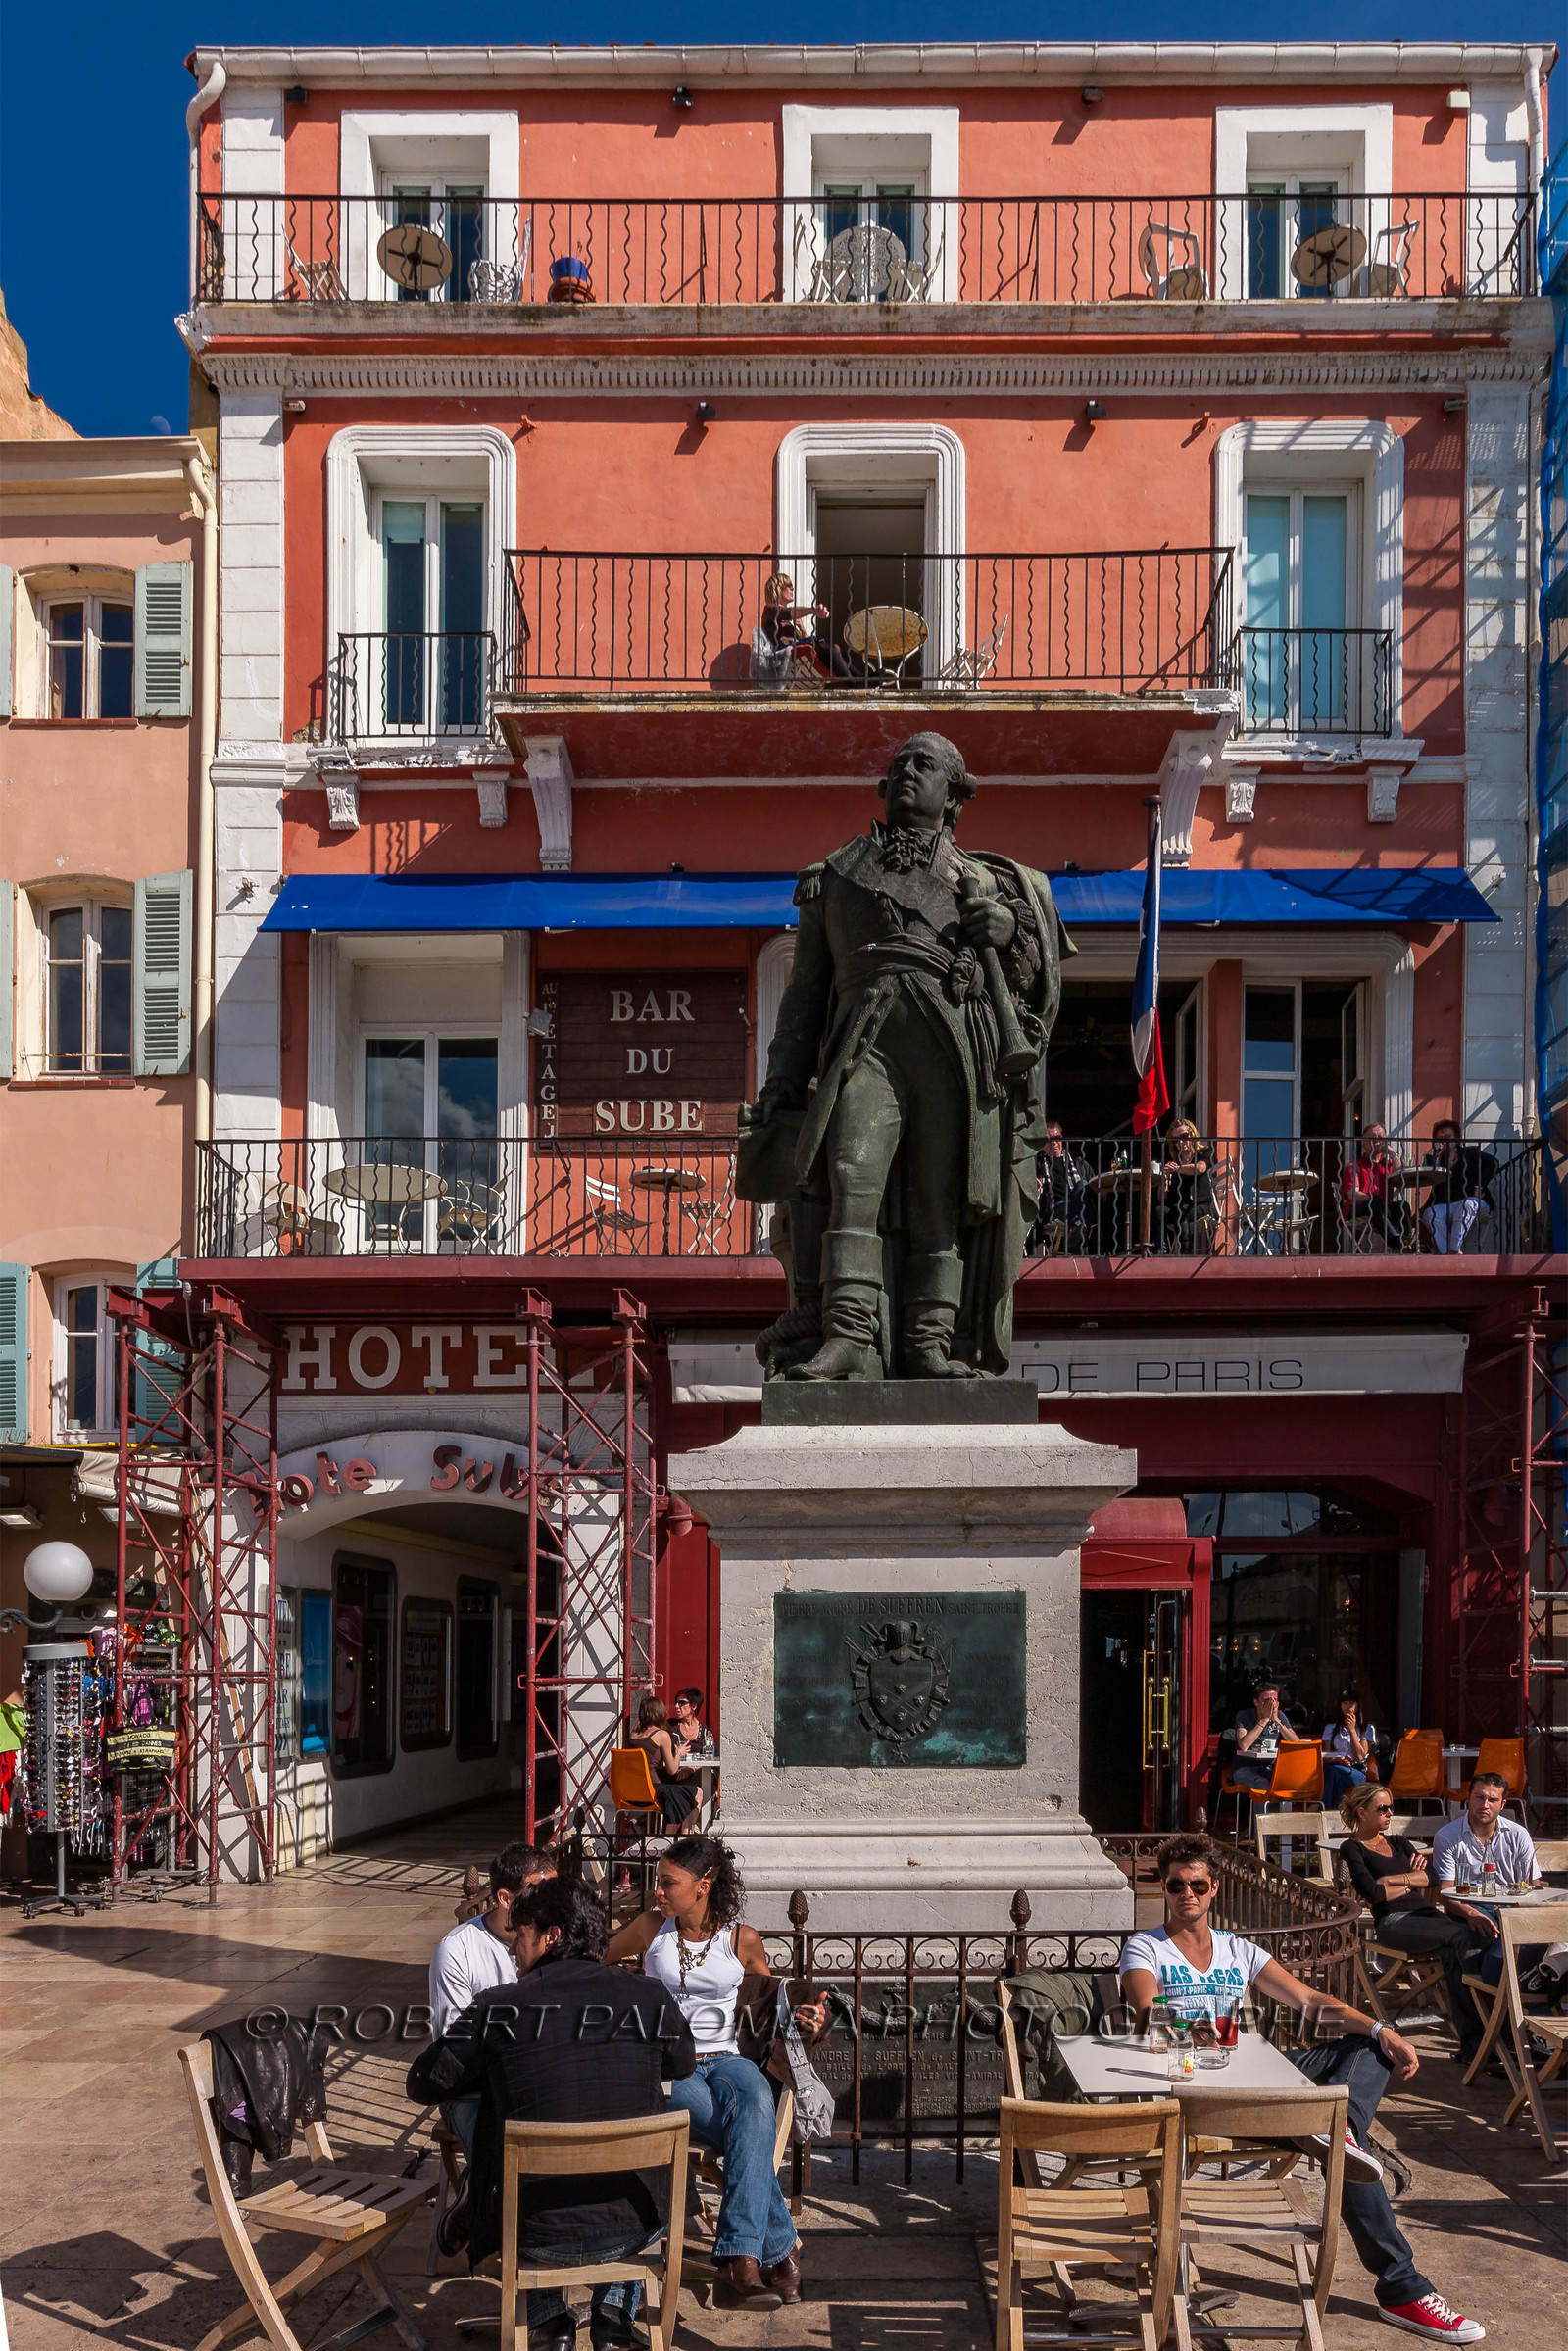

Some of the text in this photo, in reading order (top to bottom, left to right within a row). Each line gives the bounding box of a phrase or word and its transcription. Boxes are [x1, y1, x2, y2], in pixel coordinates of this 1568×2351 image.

[542, 983, 558, 995] AU
[610, 990, 695, 1021] BAR
[626, 1048, 673, 1074] DU
[595, 1100, 703, 1132] SUBE
[1021, 1359, 1303, 1393] DE PARIS
[857, 1598, 878, 1615] DE
[880, 1597, 944, 1615] SUFFREN
[1161, 1965, 1193, 1985] LAS
[874, 2050, 925, 2061] SUFFEN
[936, 2062, 958, 2071] MALT
[945, 2071, 1004, 2080] VIC-AMIRAL
